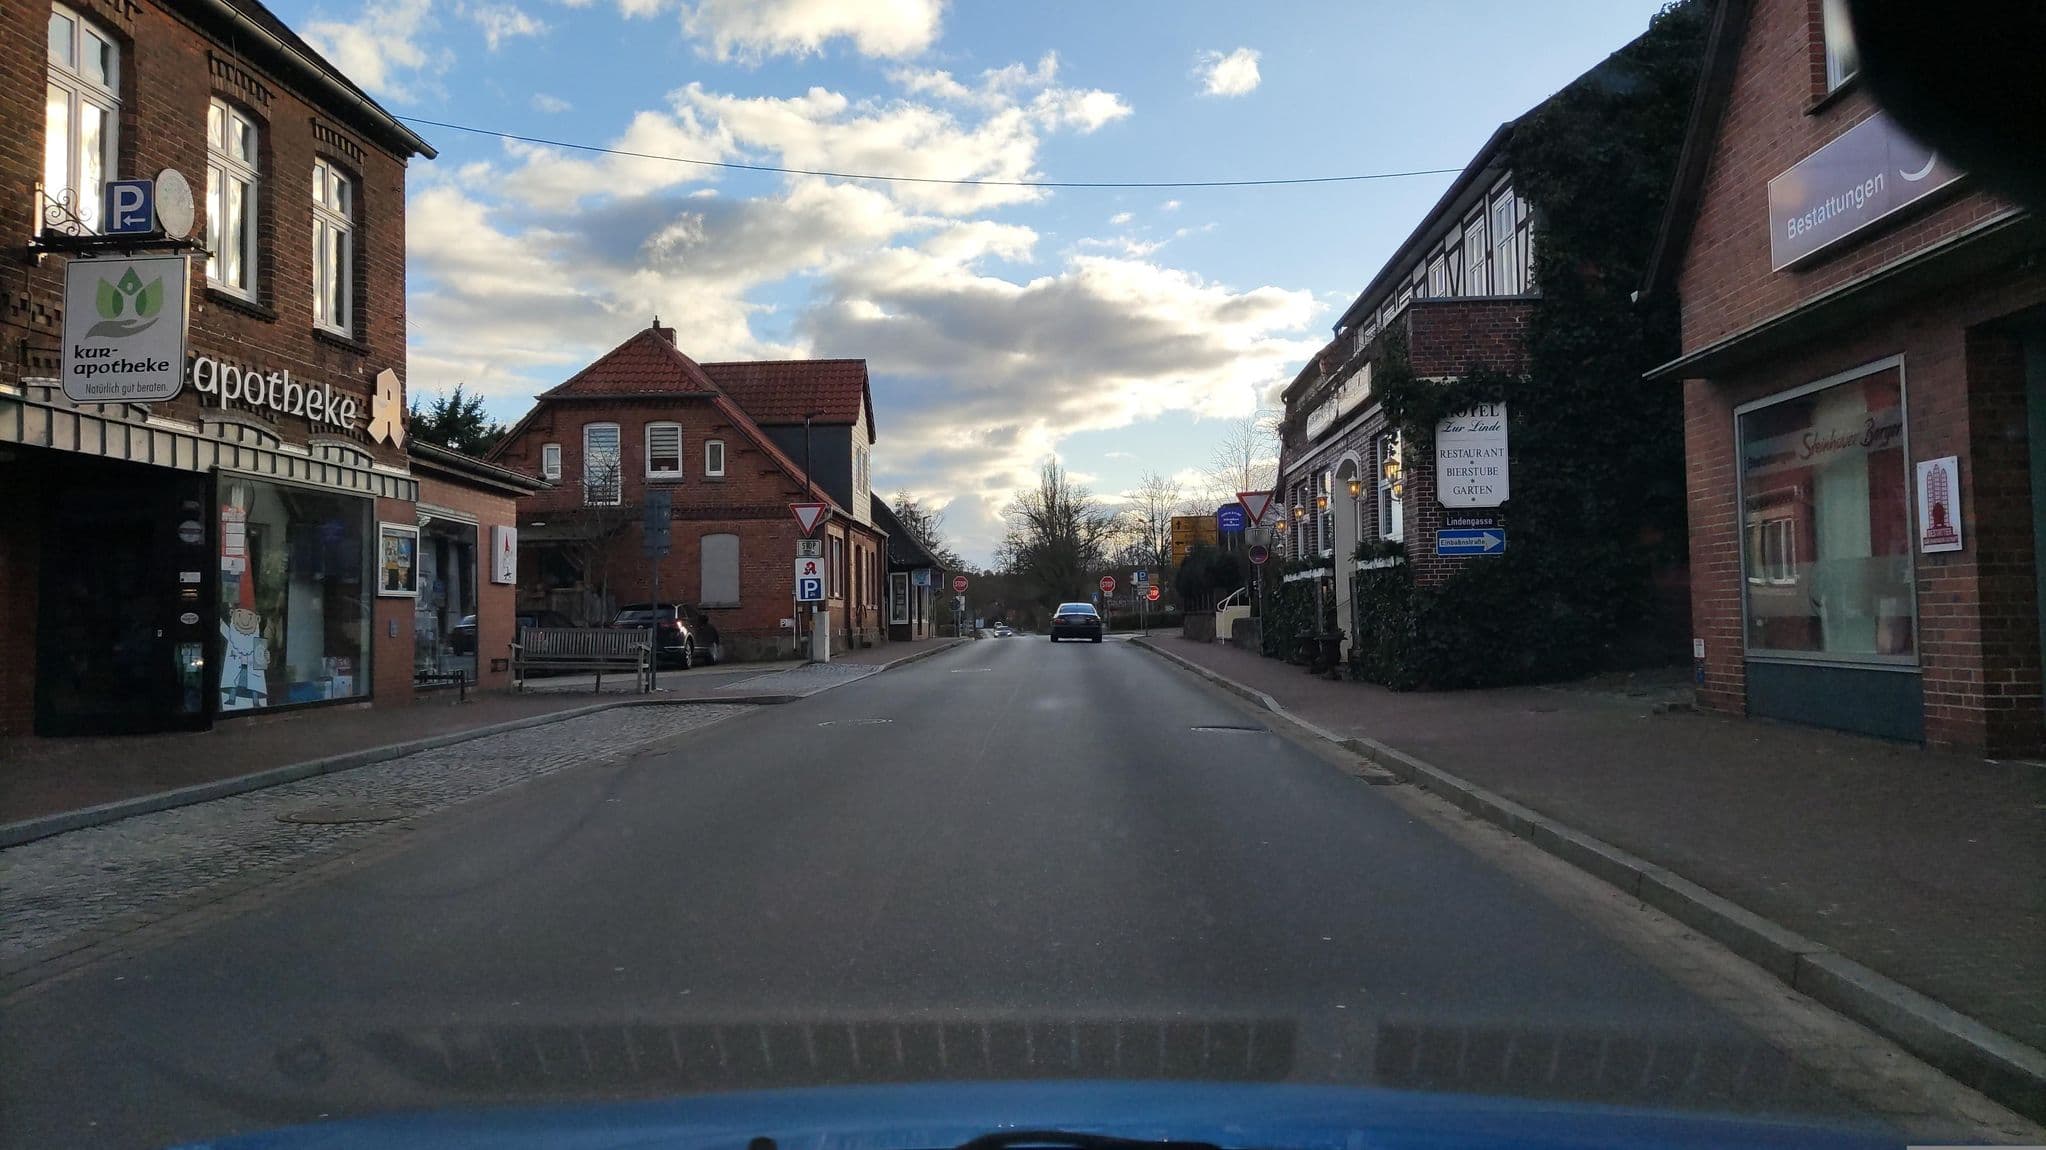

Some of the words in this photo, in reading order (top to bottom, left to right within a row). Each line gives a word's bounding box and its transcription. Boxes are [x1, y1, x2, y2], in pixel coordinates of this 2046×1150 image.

[113, 184, 145, 230] P
[1786, 172, 1885, 241] Bestattungen
[74, 344, 119, 359] kur-
[73, 357, 170, 379] apotheke
[85, 383, 120, 395] Natürlich
[121, 384, 135, 396] gut
[194, 356, 357, 430] apotheke
[1441, 421, 1466, 433] Zur
[1467, 421, 1502, 432] Linde
[1440, 448, 1505, 459] RESTAURANT
[1446, 466, 1499, 477] BIERSTUBE
[1452, 485, 1493, 495] GARTEN
[1446, 516, 1493, 527] Lindengasse
[804, 579, 818, 600] P
